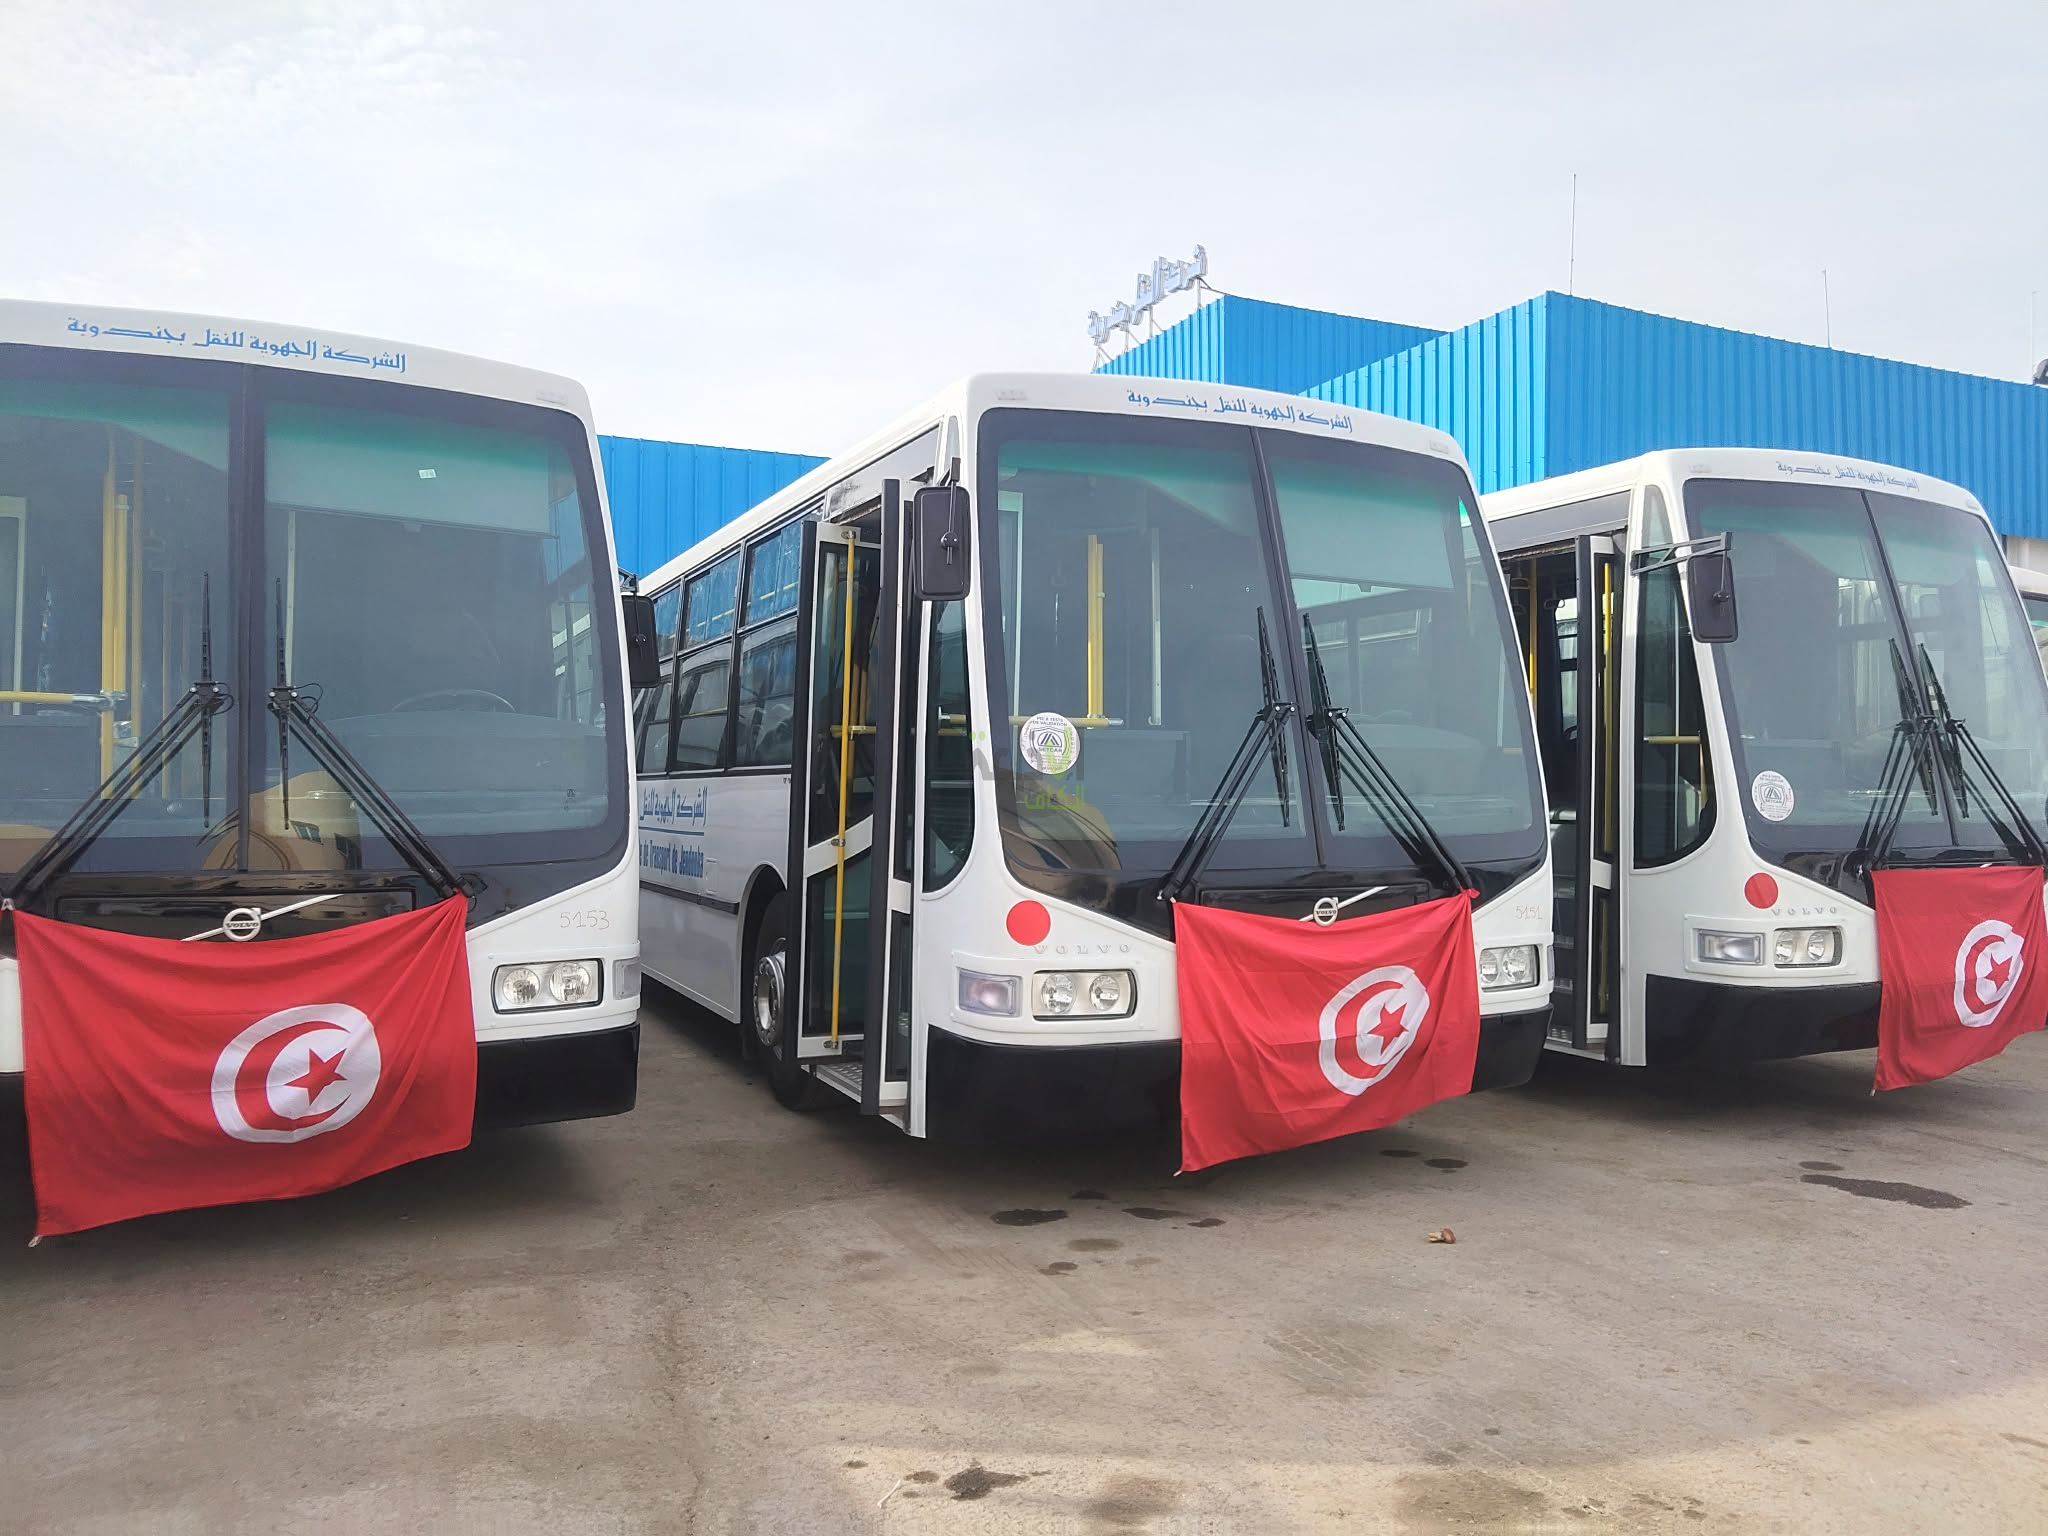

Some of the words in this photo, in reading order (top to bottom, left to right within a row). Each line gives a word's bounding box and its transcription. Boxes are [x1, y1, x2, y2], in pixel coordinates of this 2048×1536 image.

[67, 317, 187, 346] بجندوبة
[192, 328, 244, 347] للنقل
[249, 336, 317, 360] الجهوية
[322, 345, 406, 373] الشركة
[1126, 389, 1208, 412] بجندوبة
[1213, 396, 1247, 413] للنقل
[1249, 402, 1295, 423] الجهوية
[1297, 409, 1353, 433] الشركة
[559, 909, 610, 930] 5153
[1771, 905, 1838, 917] VOLVO
[225, 920, 260, 929] VOLVO
[1032, 943, 1130, 955] VOLVO
